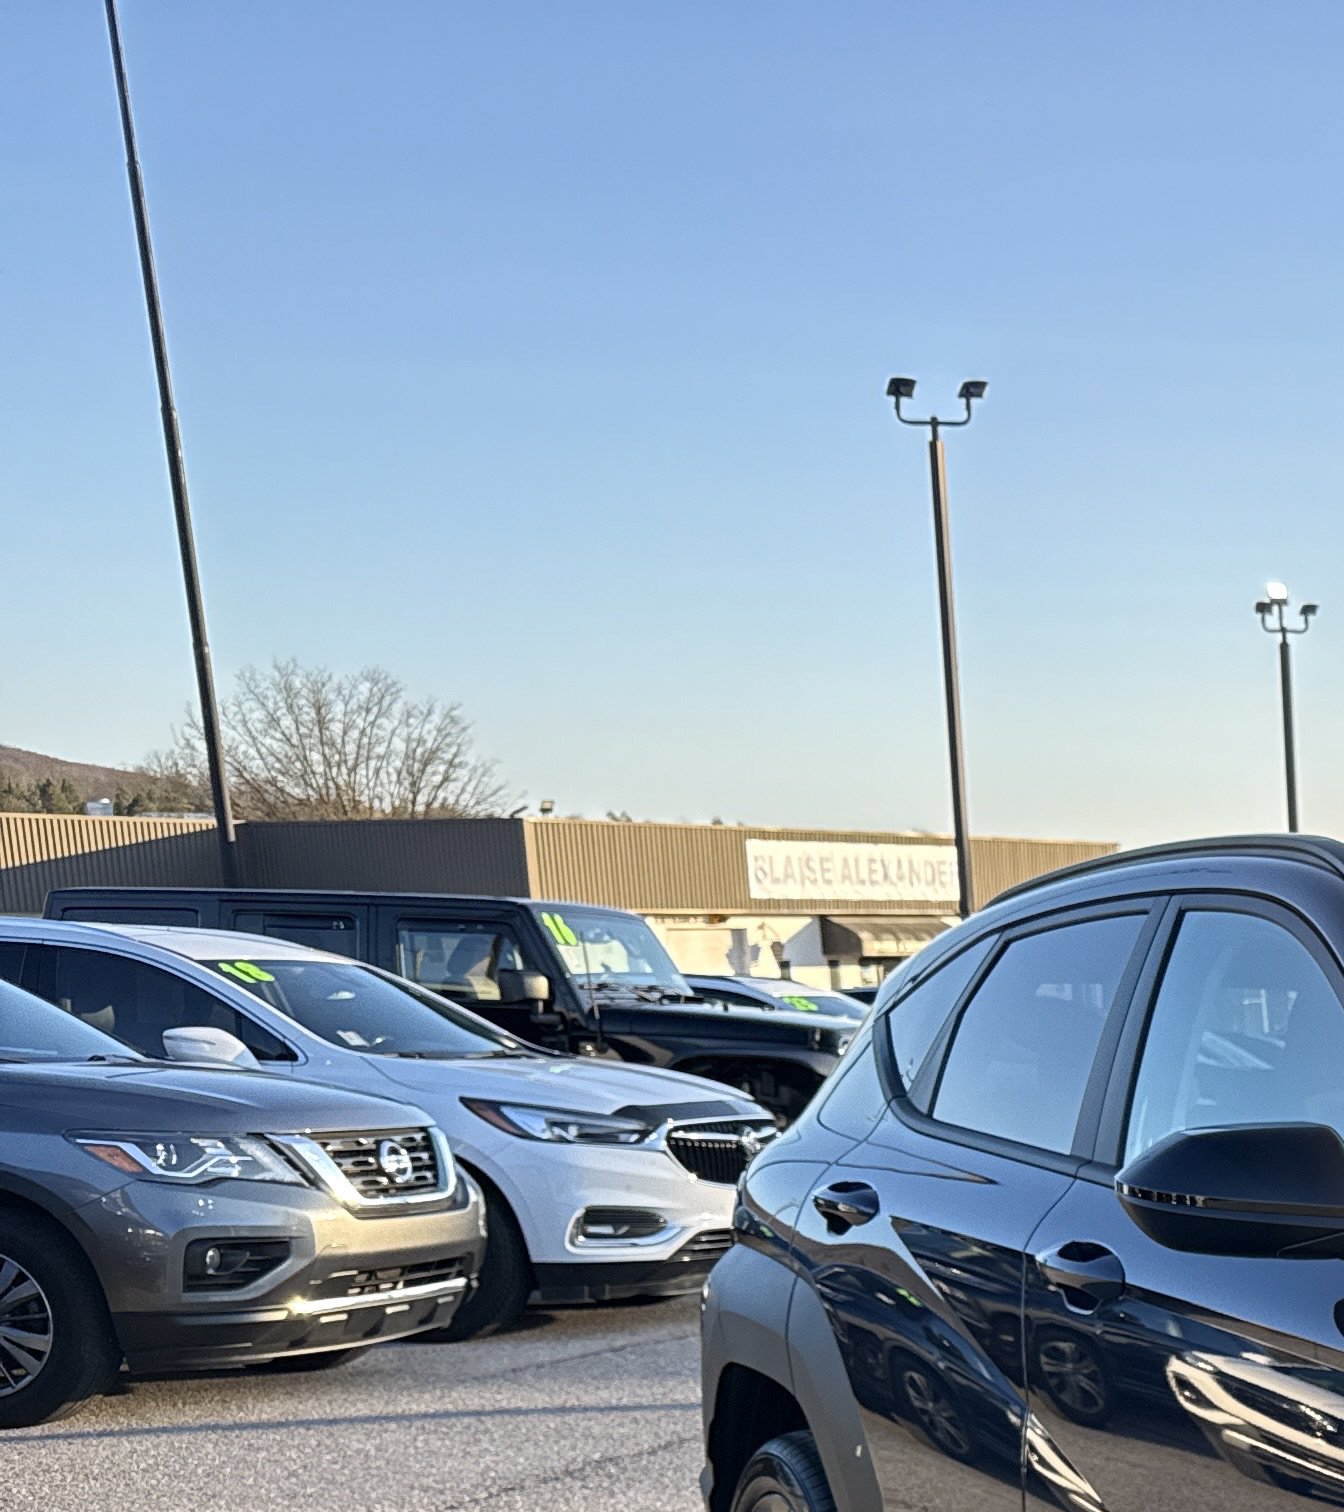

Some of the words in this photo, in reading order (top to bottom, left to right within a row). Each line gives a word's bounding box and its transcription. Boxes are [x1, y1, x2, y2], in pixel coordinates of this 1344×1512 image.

[753, 854, 833, 887] BLAISE
[840, 855, 956, 888] ALEXANDE
[218, 961, 276, 984] 18
